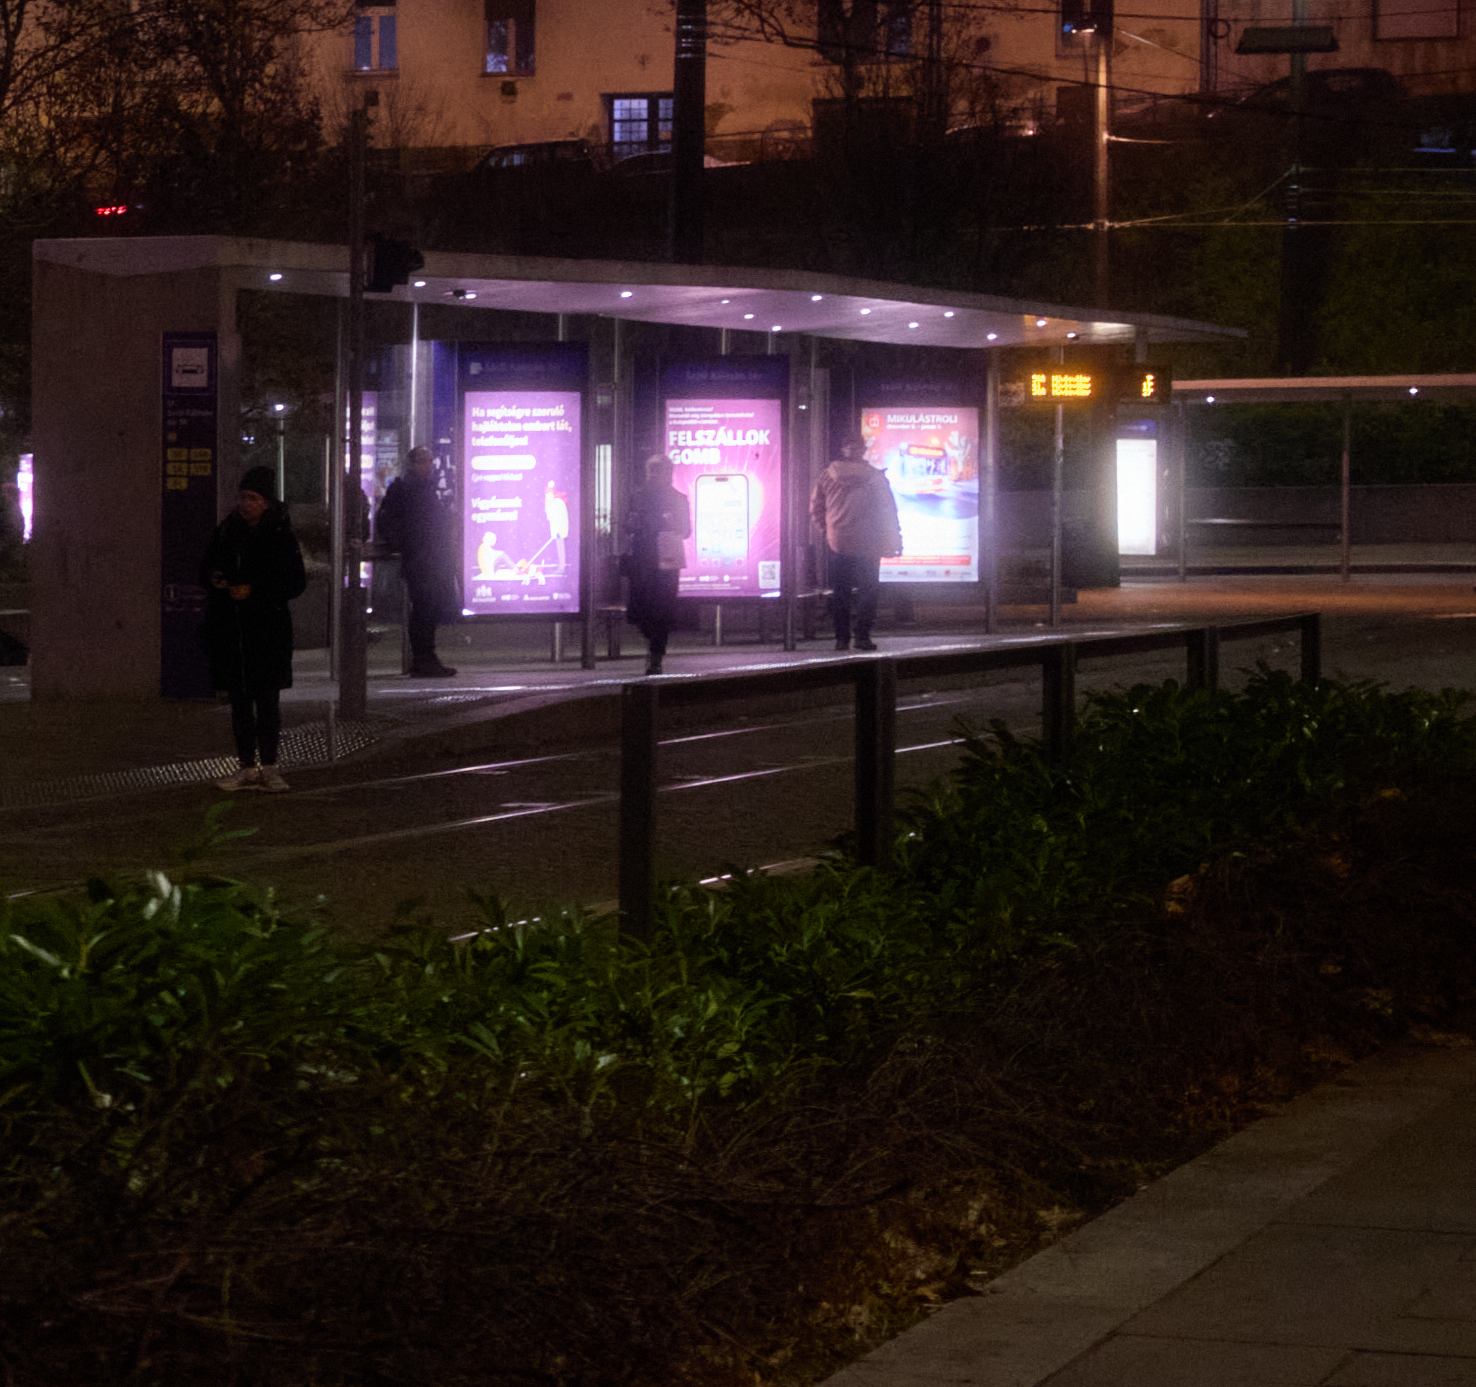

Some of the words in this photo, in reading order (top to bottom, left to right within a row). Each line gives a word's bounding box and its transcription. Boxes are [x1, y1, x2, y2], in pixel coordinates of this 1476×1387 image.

[472, 407, 486, 417] Ha
[887, 413, 958, 424] MIKULÁSTROLI
[668, 426, 771, 447] FELSZÁLLOK
[668, 447, 721, 465] GOMB
